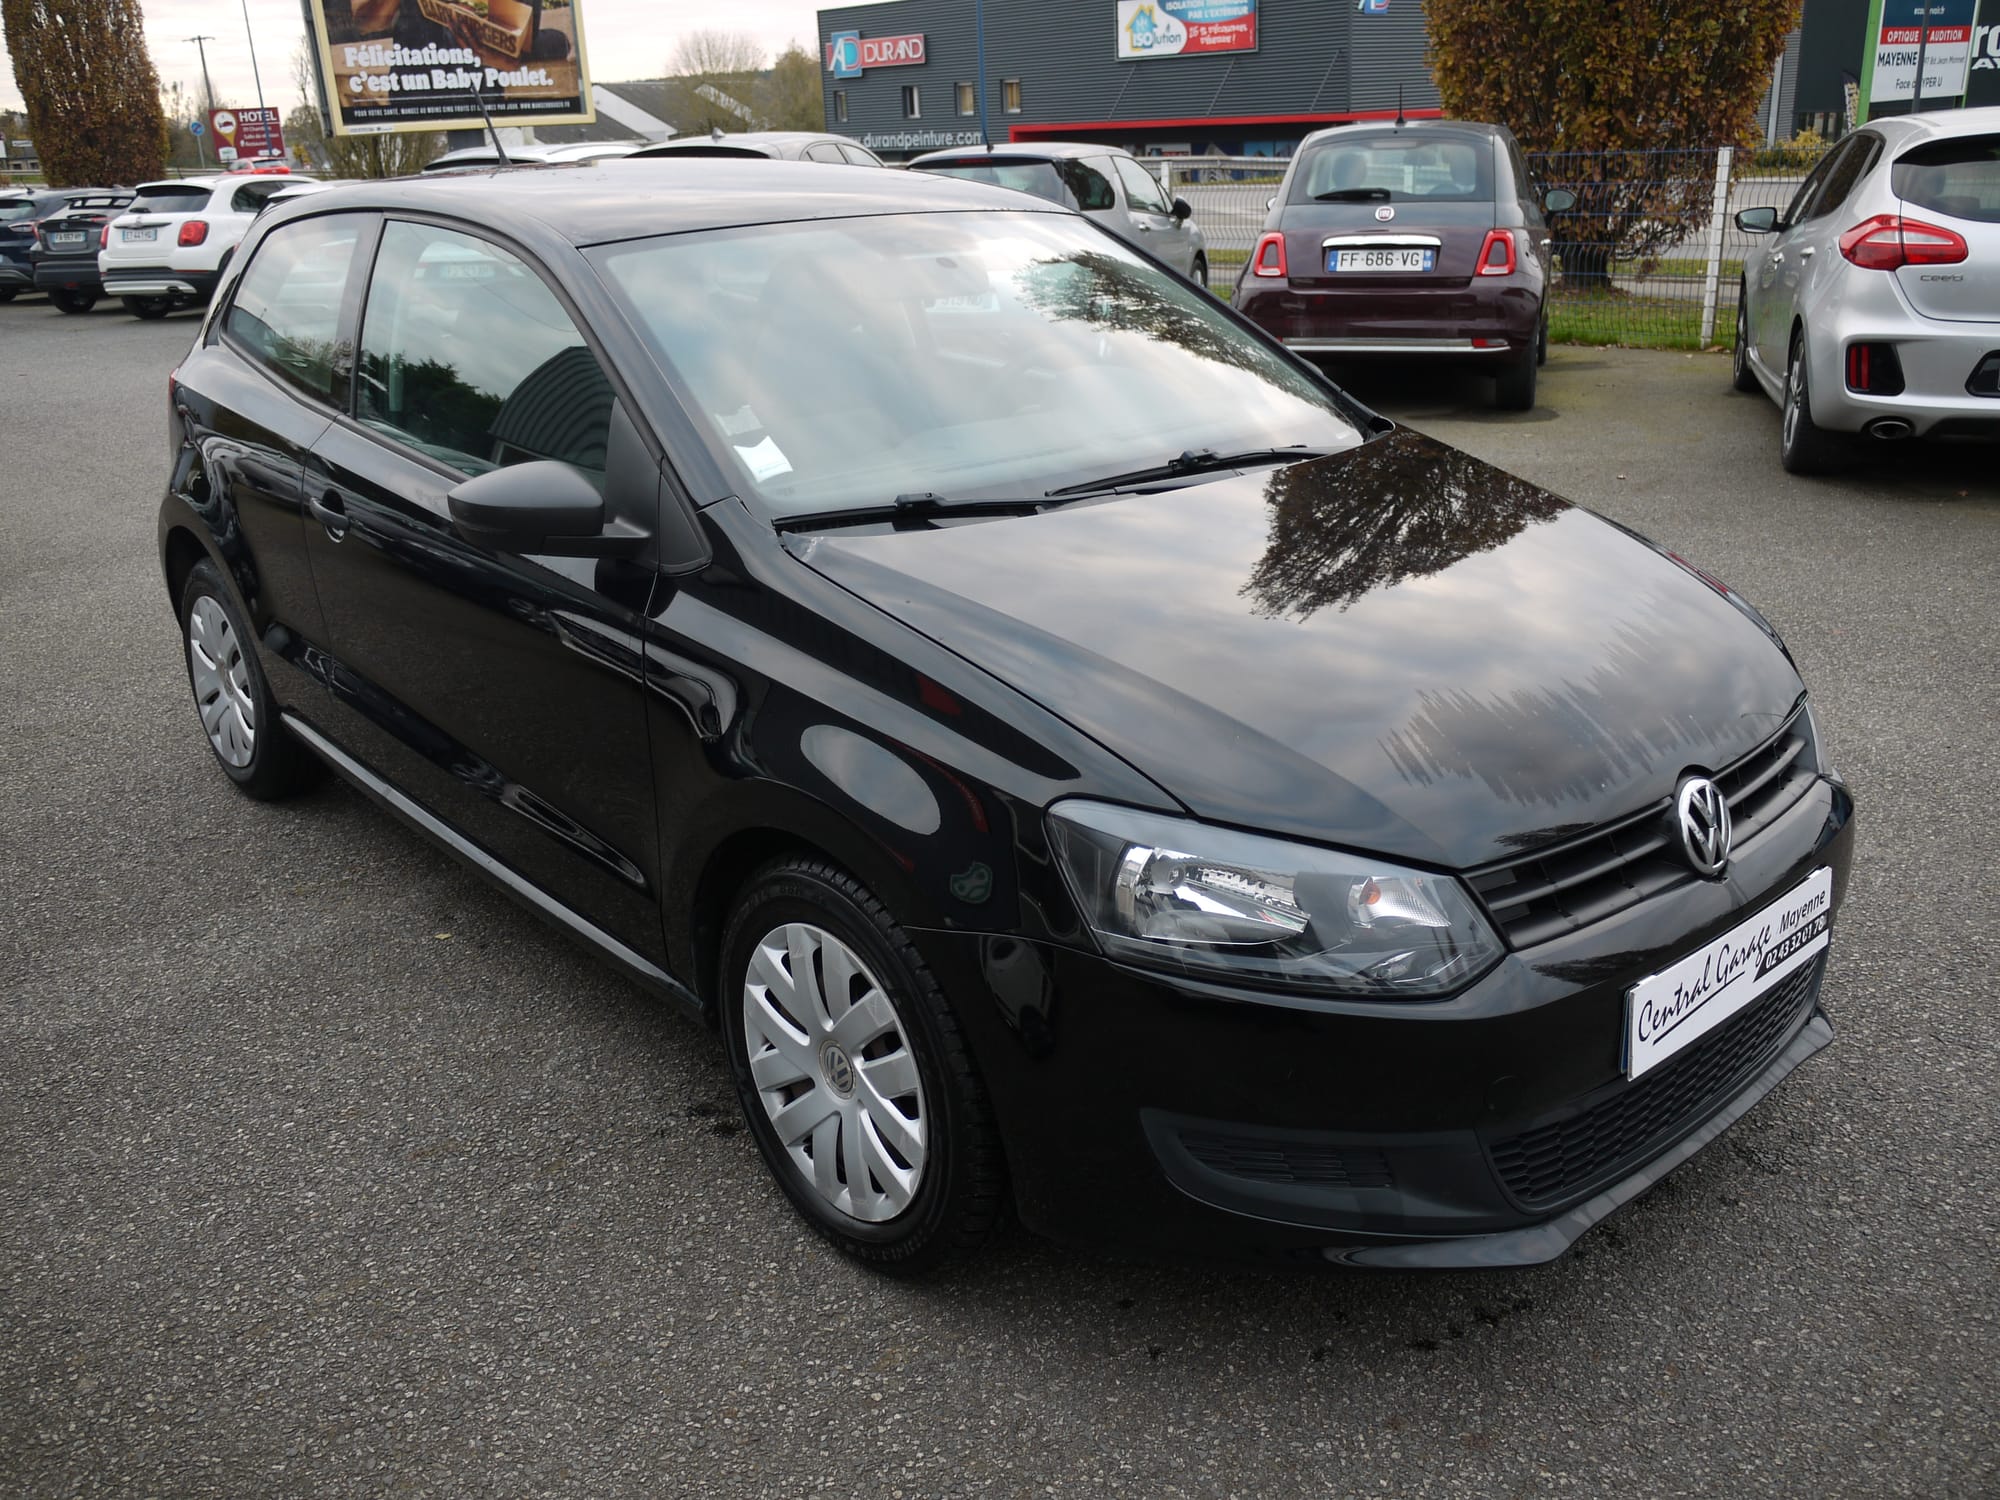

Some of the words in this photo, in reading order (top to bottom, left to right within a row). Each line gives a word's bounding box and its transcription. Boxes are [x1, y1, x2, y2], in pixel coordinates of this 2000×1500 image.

[1887, 31, 1919, 42] OPTIQUE
[1930, 30, 1963, 42] AUDITION
[344, 43, 481, 67] Félicitations,
[864, 39, 923, 62] DURAND
[1878, 51, 1918, 67] MAYENNE
[349, 71, 399, 93] c'est
[401, 74, 431, 91] un
[431, 67, 483, 92] Baby
[485, 66, 554, 88] Poulet.
[1896, 79, 1910, 89] Face
[1937, 75, 1943, 87] U
[239, 110, 277, 122] HOTEL
[1340, 252, 1420, 267] FF-686-VG
[1638, 953, 1712, 1042] Central
[1716, 923, 1772, 985] Garage
[1779, 890, 1826, 934] Mayenne
